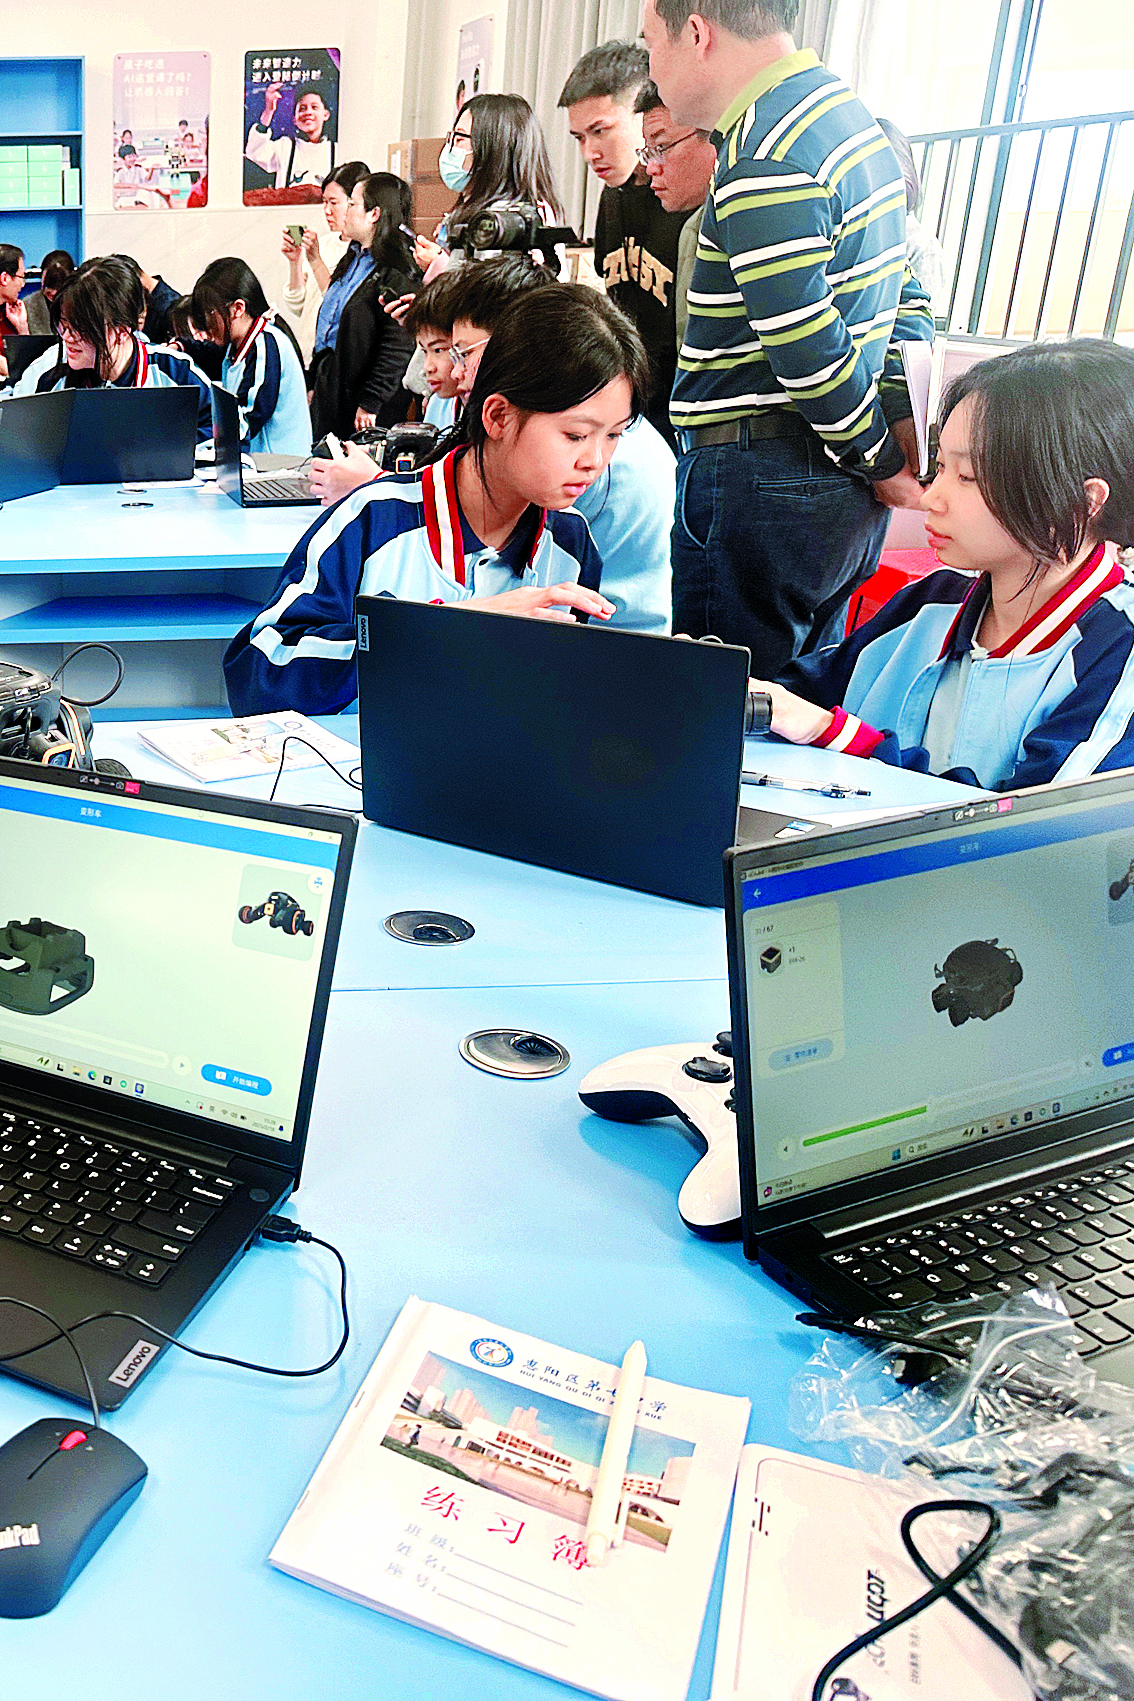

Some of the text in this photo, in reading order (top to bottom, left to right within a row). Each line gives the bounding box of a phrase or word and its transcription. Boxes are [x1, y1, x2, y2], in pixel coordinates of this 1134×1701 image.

[359, 617, 368, 649] Lenovo
[116, 1345, 151, 1382] Lenovo
[519, 1369, 535, 1379] HUI
[539, 1375, 562, 1388] YANG
[522, 1358, 667, 1412] 惠阳区第七学
[421, 1486, 591, 1570] 练习簿
